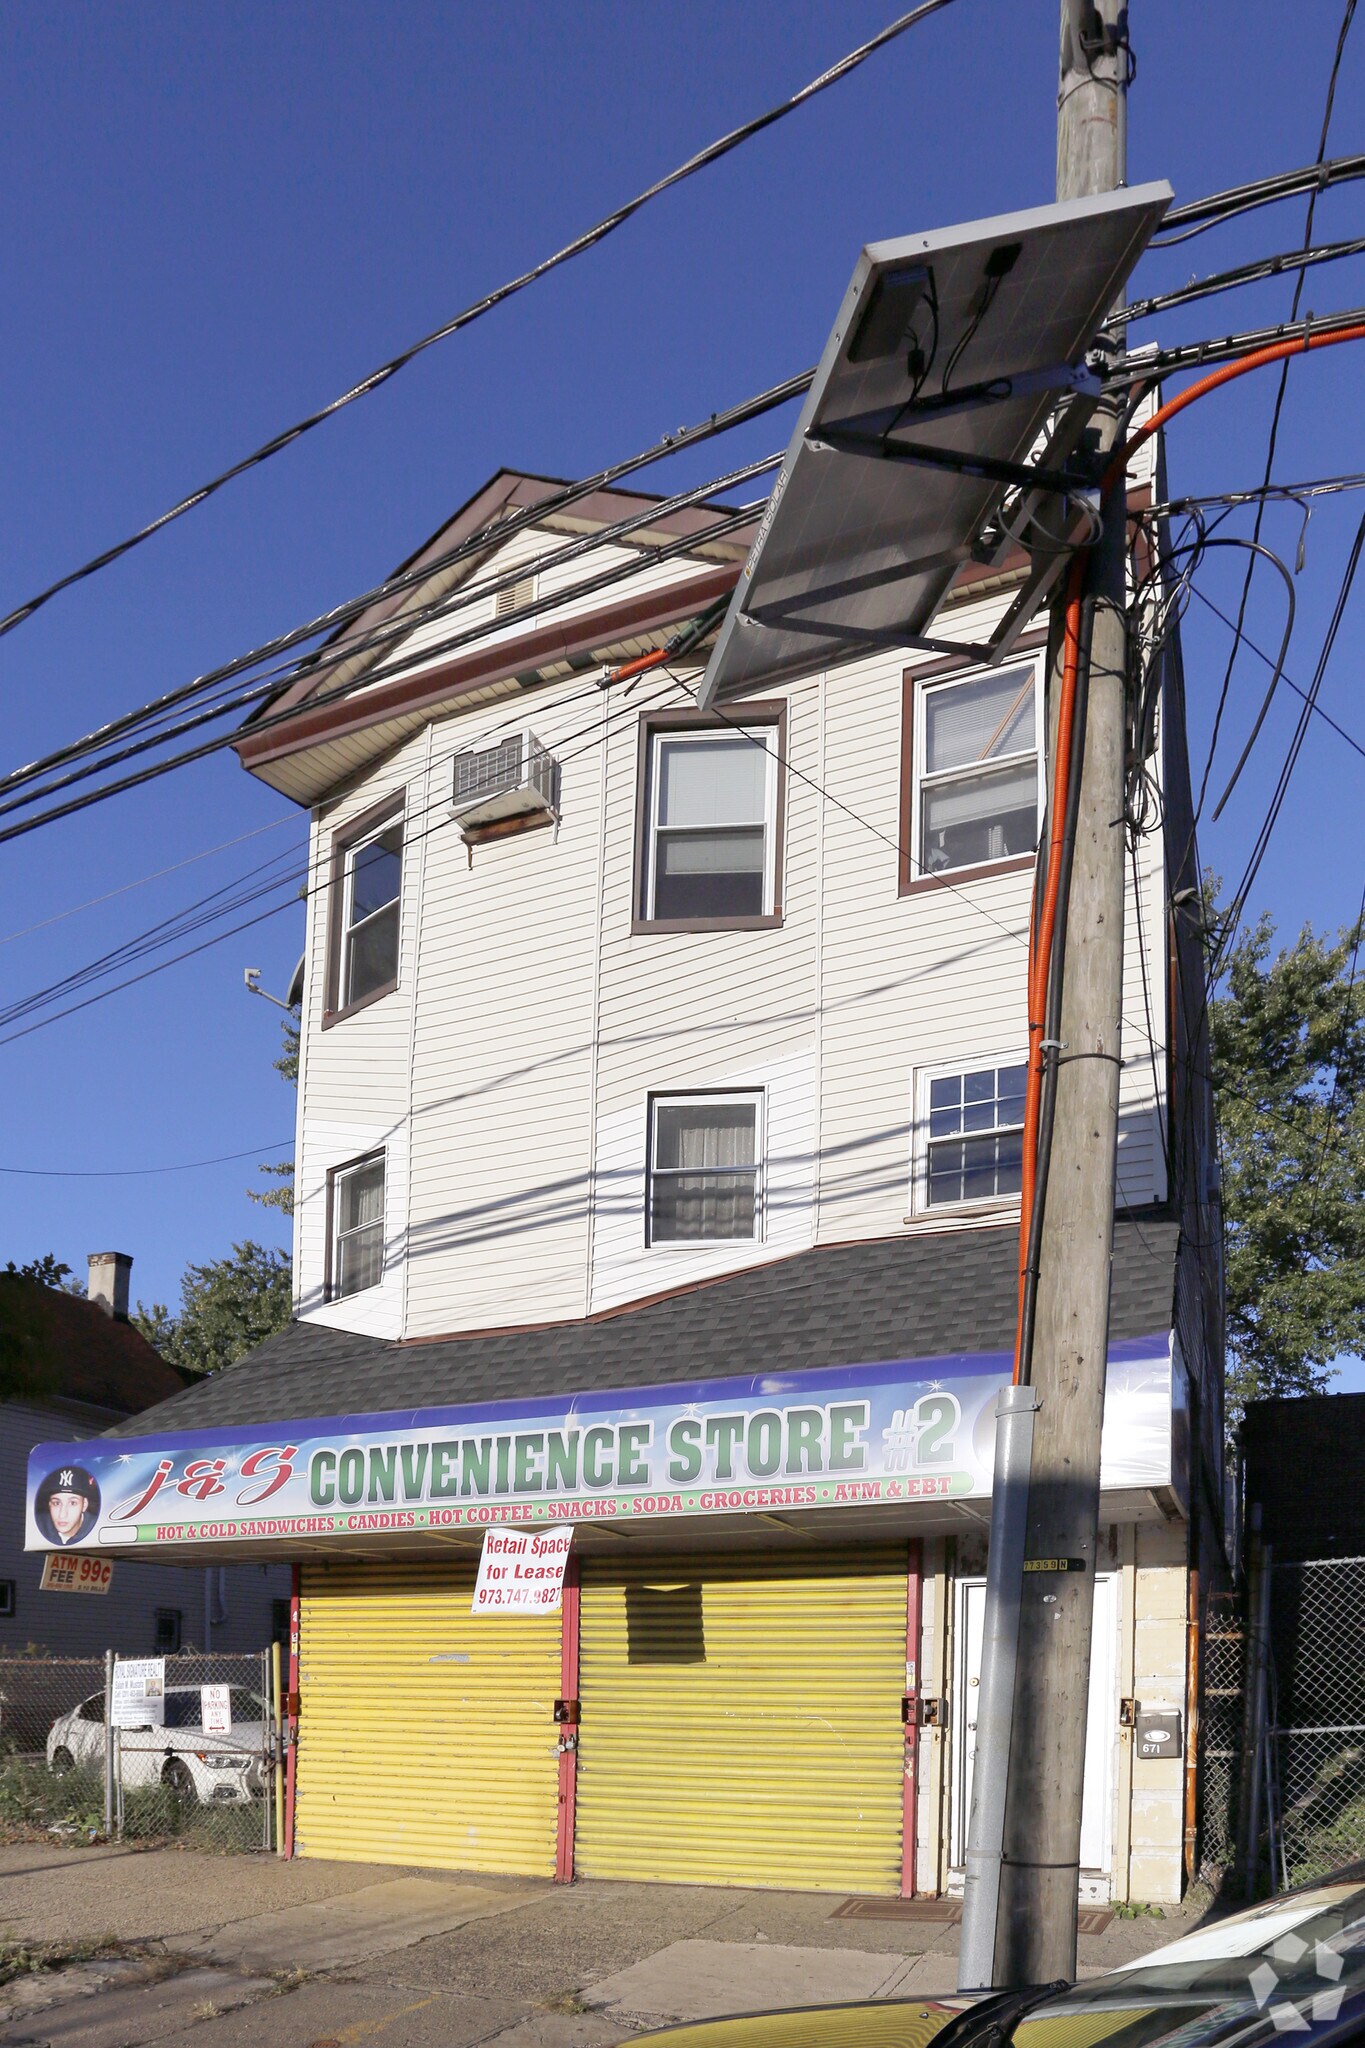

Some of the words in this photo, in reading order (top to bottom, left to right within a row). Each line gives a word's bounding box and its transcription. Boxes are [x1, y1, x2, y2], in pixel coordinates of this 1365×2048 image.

[748, 526, 768, 571] PETRA
[765, 468, 788, 524] SOLAR
[310, 1424, 651, 1506] CONVENIENCE
[669, 1404, 866, 1482] STORE
[156, 1526, 185, 1540] HOT
[187, 1525, 197, 1538] &
[199, 1522, 238, 1537] COLD
[239, 1516, 335, 1536] SANDWICHES
[347, 1511, 416, 1530] CANDIES
[428, 1509, 463, 1526] HOT
[466, 1504, 533, 1523] COFFEE
[548, 1499, 617, 1519] SNACKS
[633, 1495, 683, 1514] SODA
[700, 1485, 816, 1510] GROCERIES
[834, 1482, 881, 1500] ATM
[886, 1480, 902, 1498] &
[907, 1476, 952, 1495] EBT
[486, 1535, 528, 1554] Retail
[530, 1535, 571, 1558] Space
[50, 1555, 79, 1571] ATM
[49, 1569, 75, 1584] FEE
[486, 1564, 508, 1580] for
[514, 1564, 563, 1579] Lease
[479, 1586, 561, 1605] 973.747.9827
[210, 1690, 220, 1699] NO
[204, 1700, 228, 1710] PARKING
[210, 1717, 223, 1725] TIME
[1142, 1743, 1160, 1754] 671
